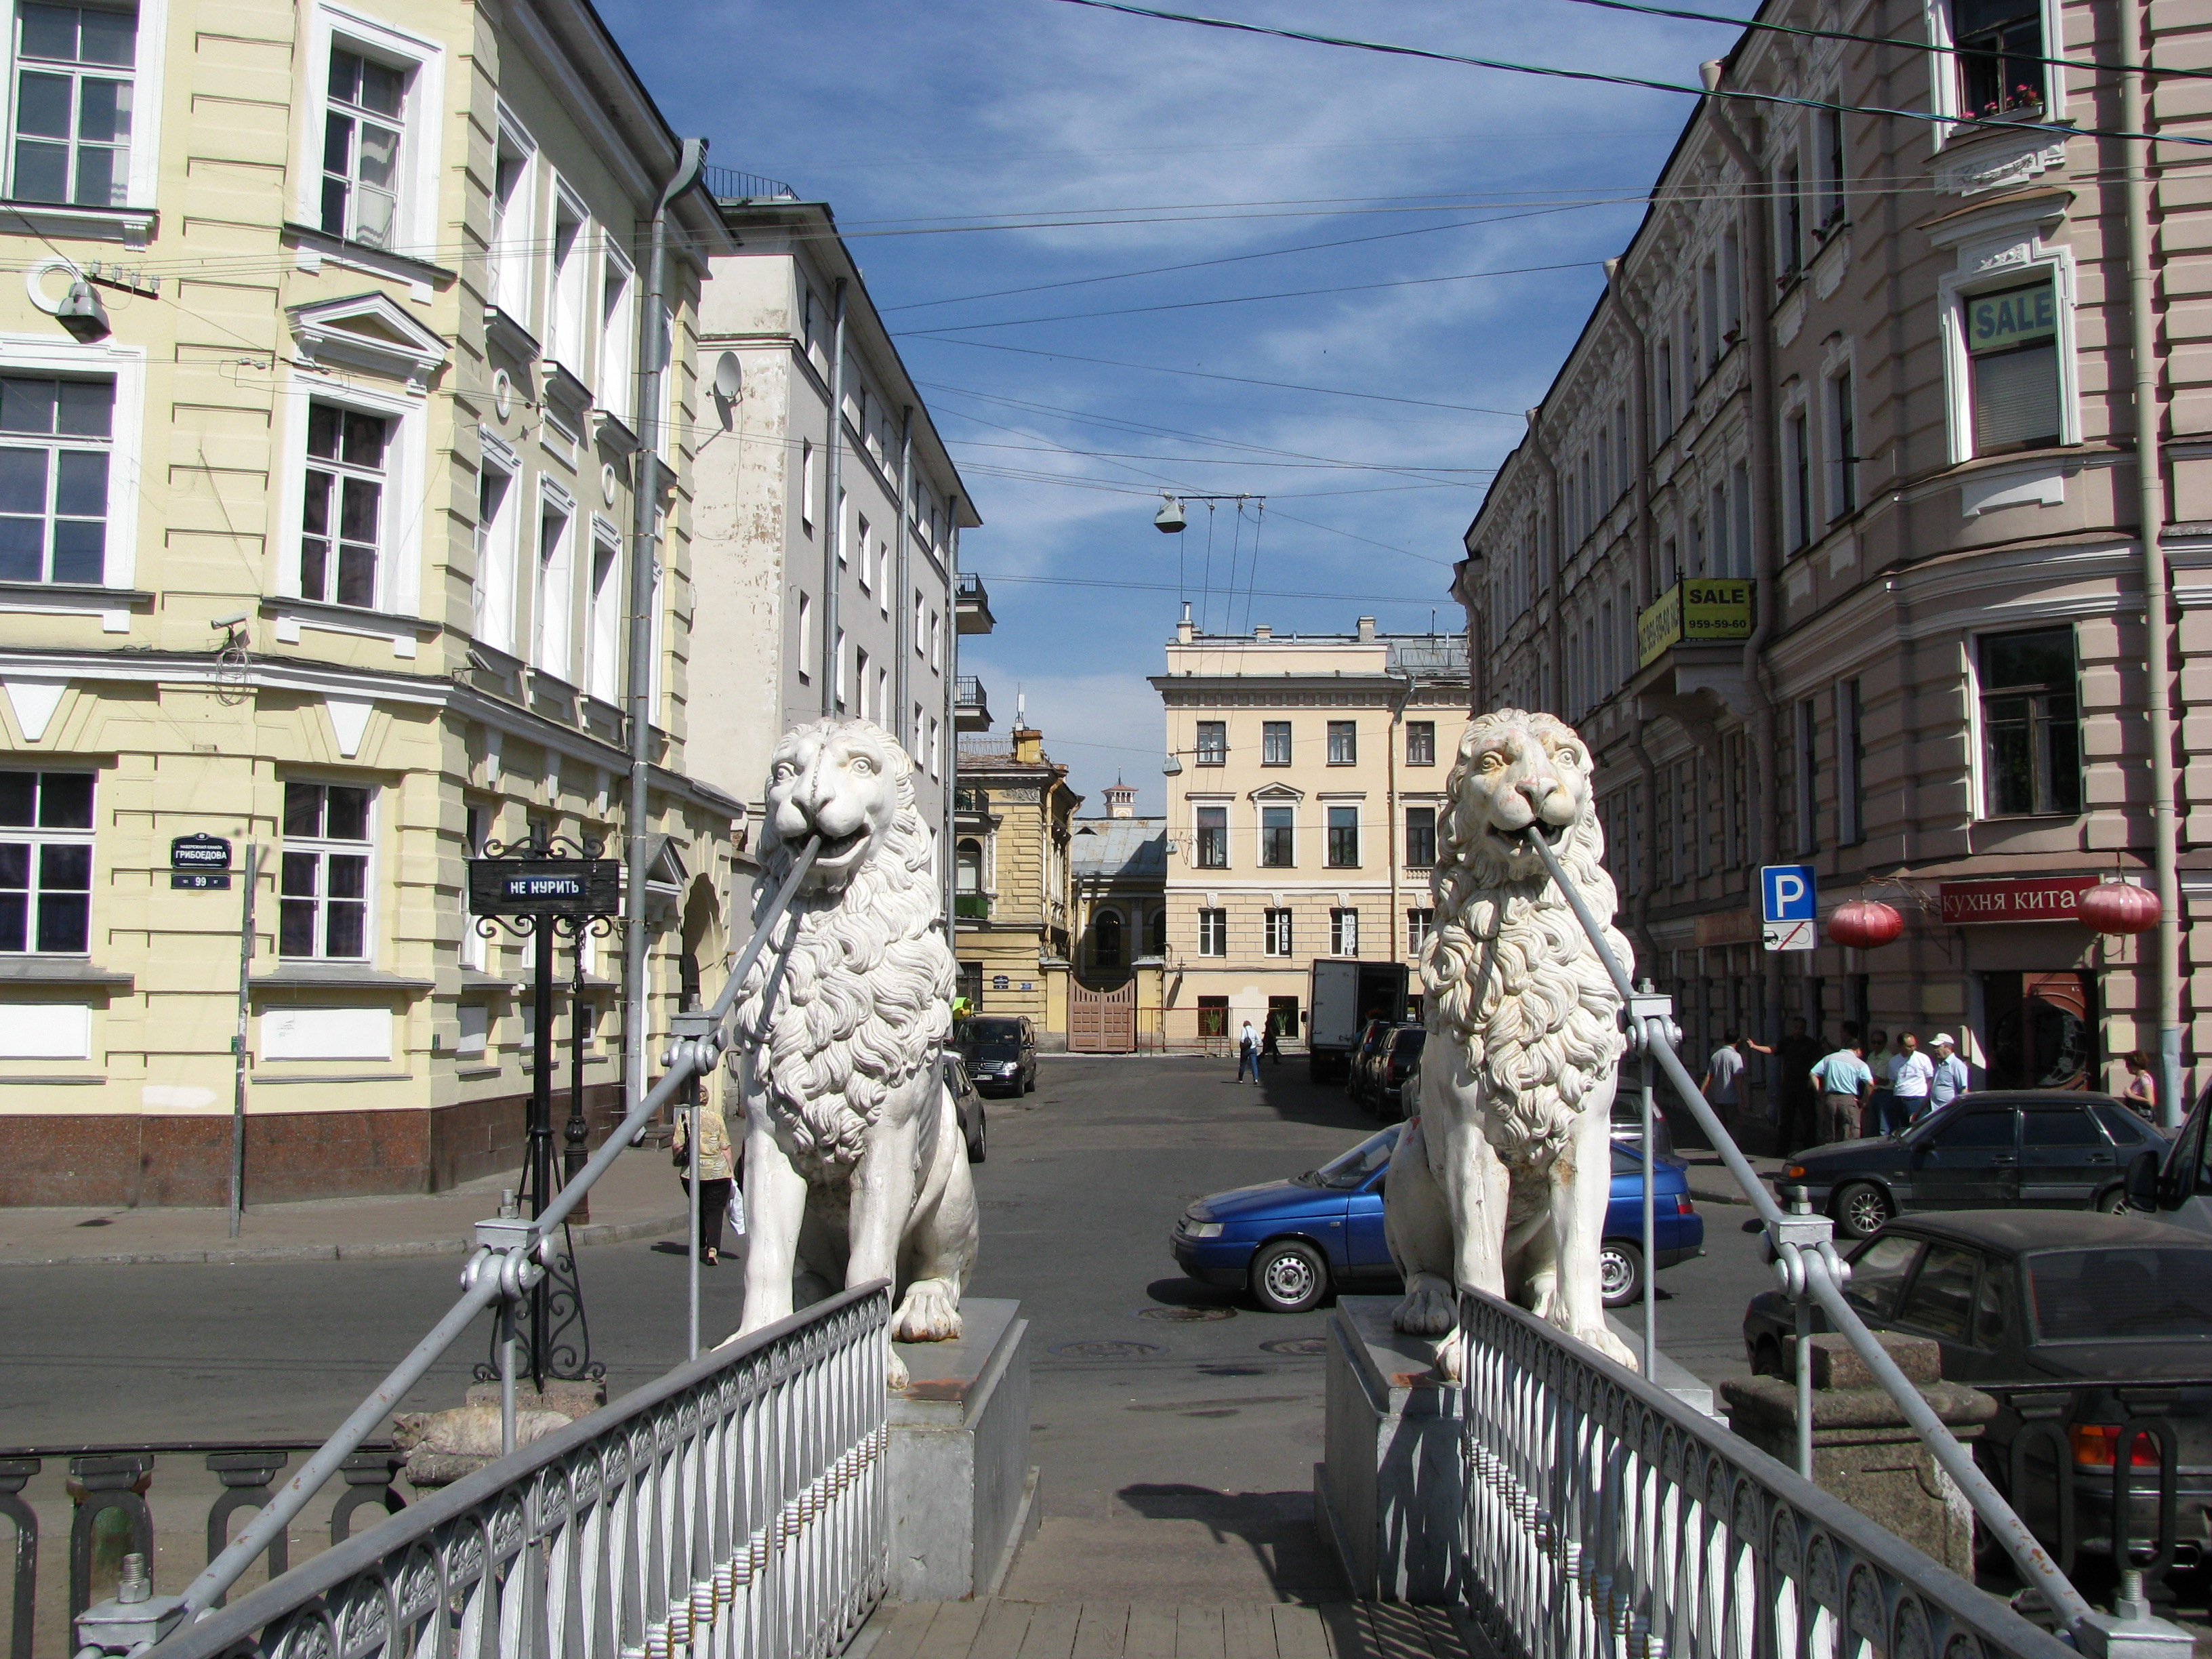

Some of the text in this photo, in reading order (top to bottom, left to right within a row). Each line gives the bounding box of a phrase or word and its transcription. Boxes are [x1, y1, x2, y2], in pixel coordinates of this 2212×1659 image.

[1975, 290, 2055, 340] SALE
[1689, 589, 1745, 605] SALE
[1689, 619, 1747, 629] 959-59-60
[176, 851, 227, 861] ГРИБОЕДОВА
[195, 876, 207, 886] 99
[510, 880, 580, 894] НЕ КУРИТЬ
[1775, 874, 1805, 918] P
[2015, 888, 2088, 910] кита
